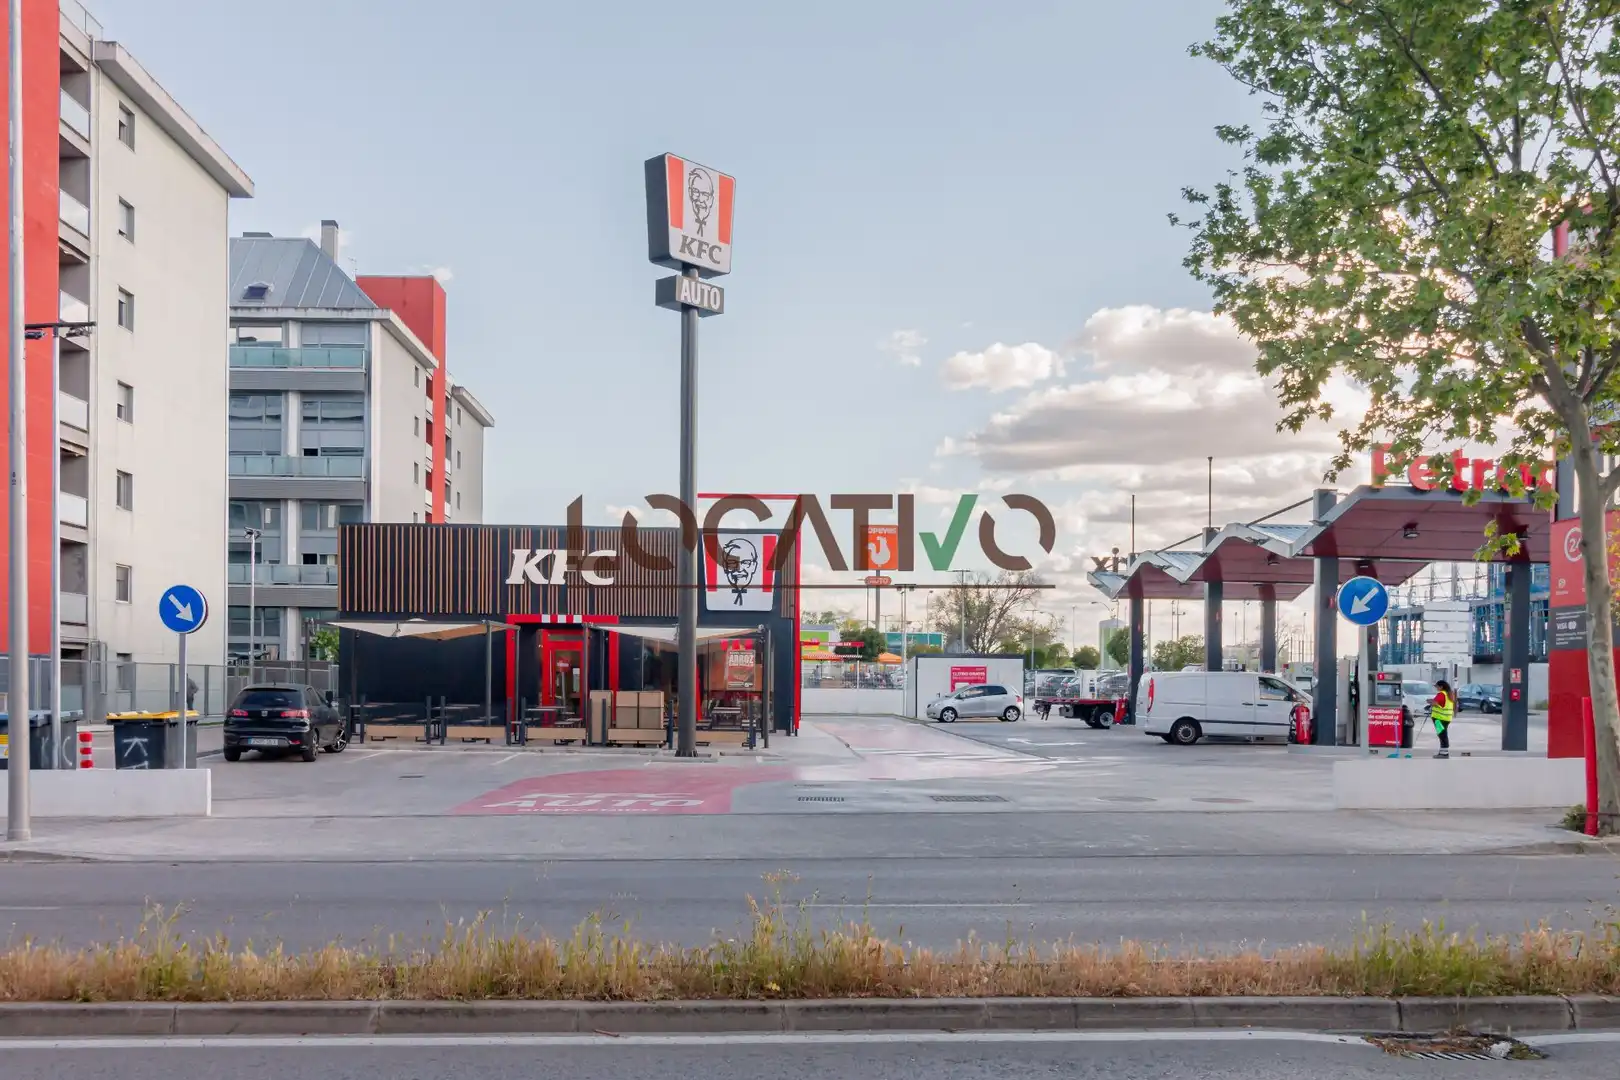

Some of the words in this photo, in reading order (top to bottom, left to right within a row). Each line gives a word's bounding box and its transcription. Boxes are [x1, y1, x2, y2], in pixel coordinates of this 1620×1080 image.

[679, 234, 722, 265] KFC
[680, 279, 721, 310] AUTO
[505, 548, 618, 586] KFC
[480, 799, 704, 807] AUTO
